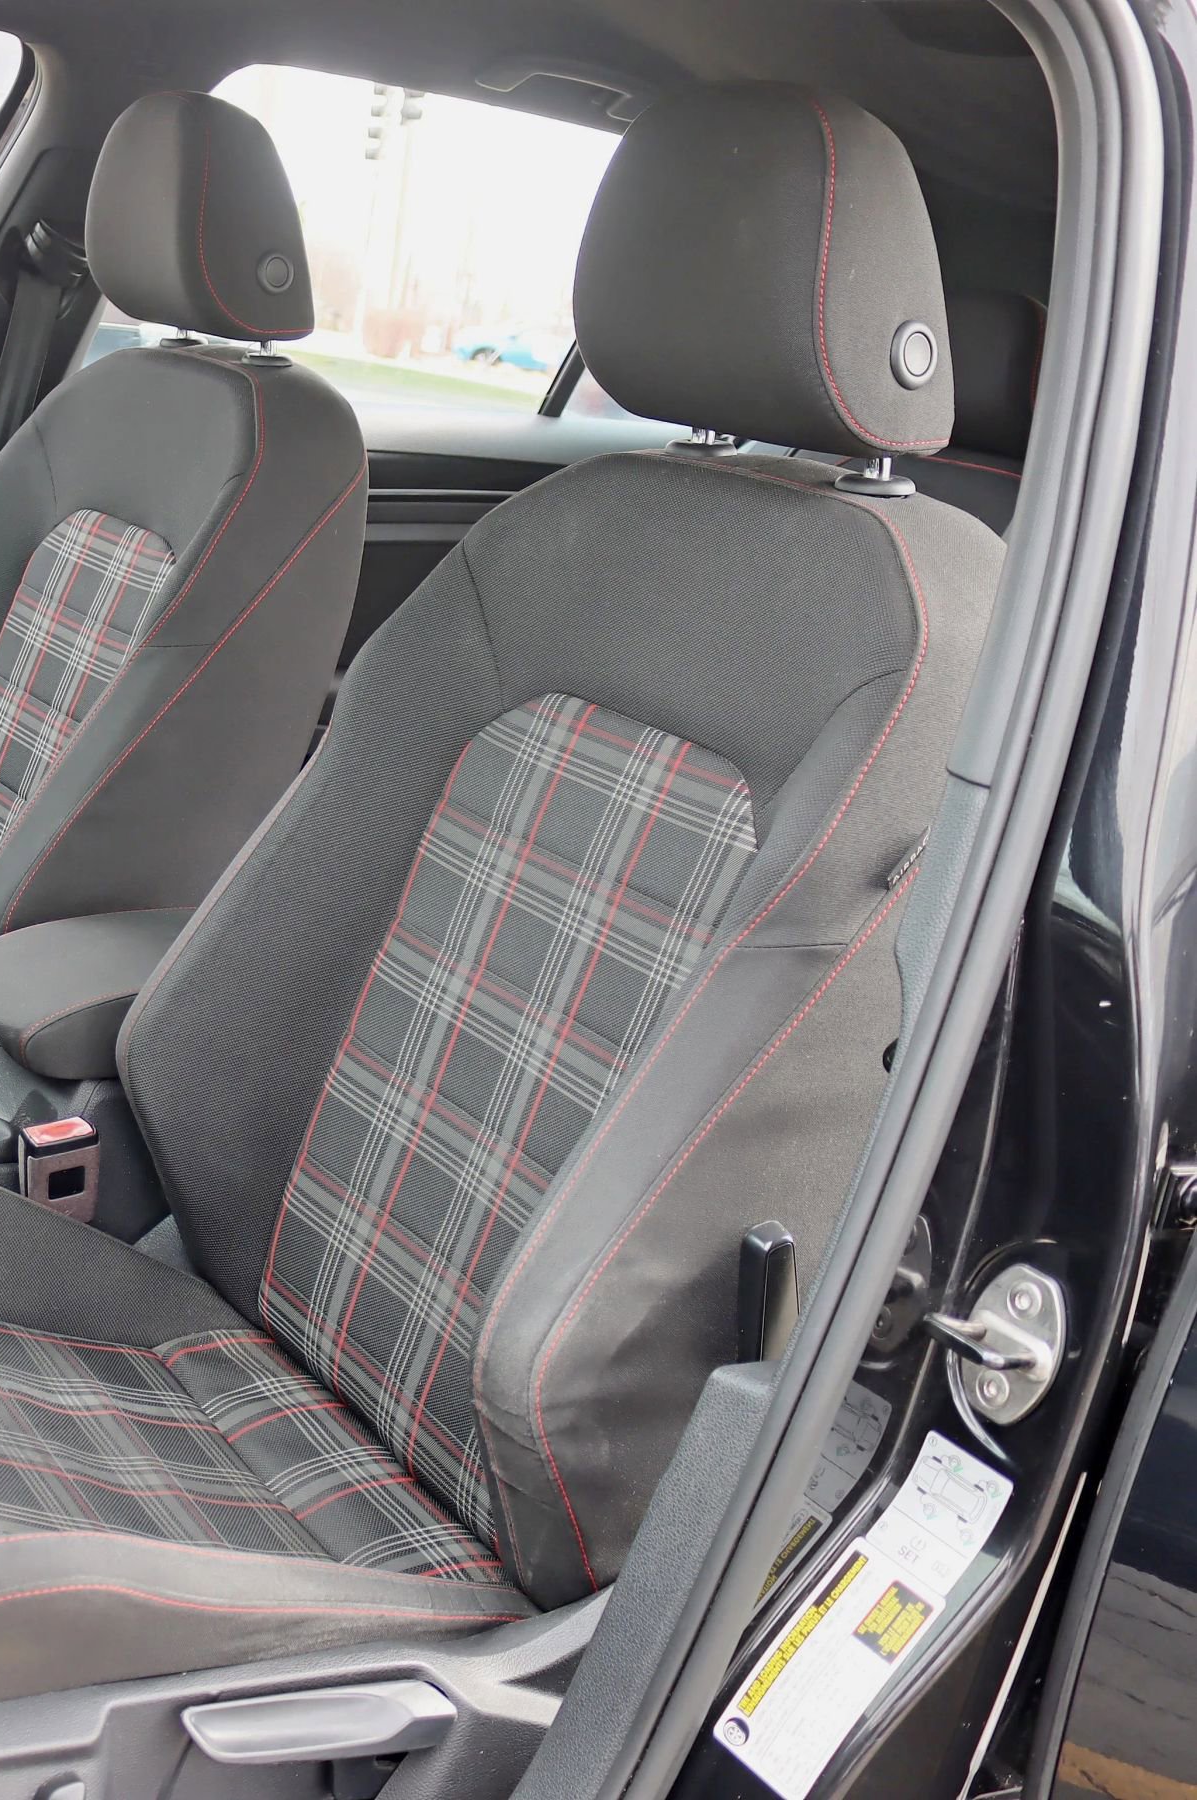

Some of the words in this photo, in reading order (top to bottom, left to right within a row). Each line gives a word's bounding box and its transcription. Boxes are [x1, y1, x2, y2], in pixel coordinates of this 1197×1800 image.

[893, 829, 930, 885] AIRBAG
[830, 1555, 868, 1599] CHARGEMENT
[898, 1545, 920, 1563] SET
[747, 1679, 762, 1698] AND
[779, 1605, 818, 1651] INFORMATION
